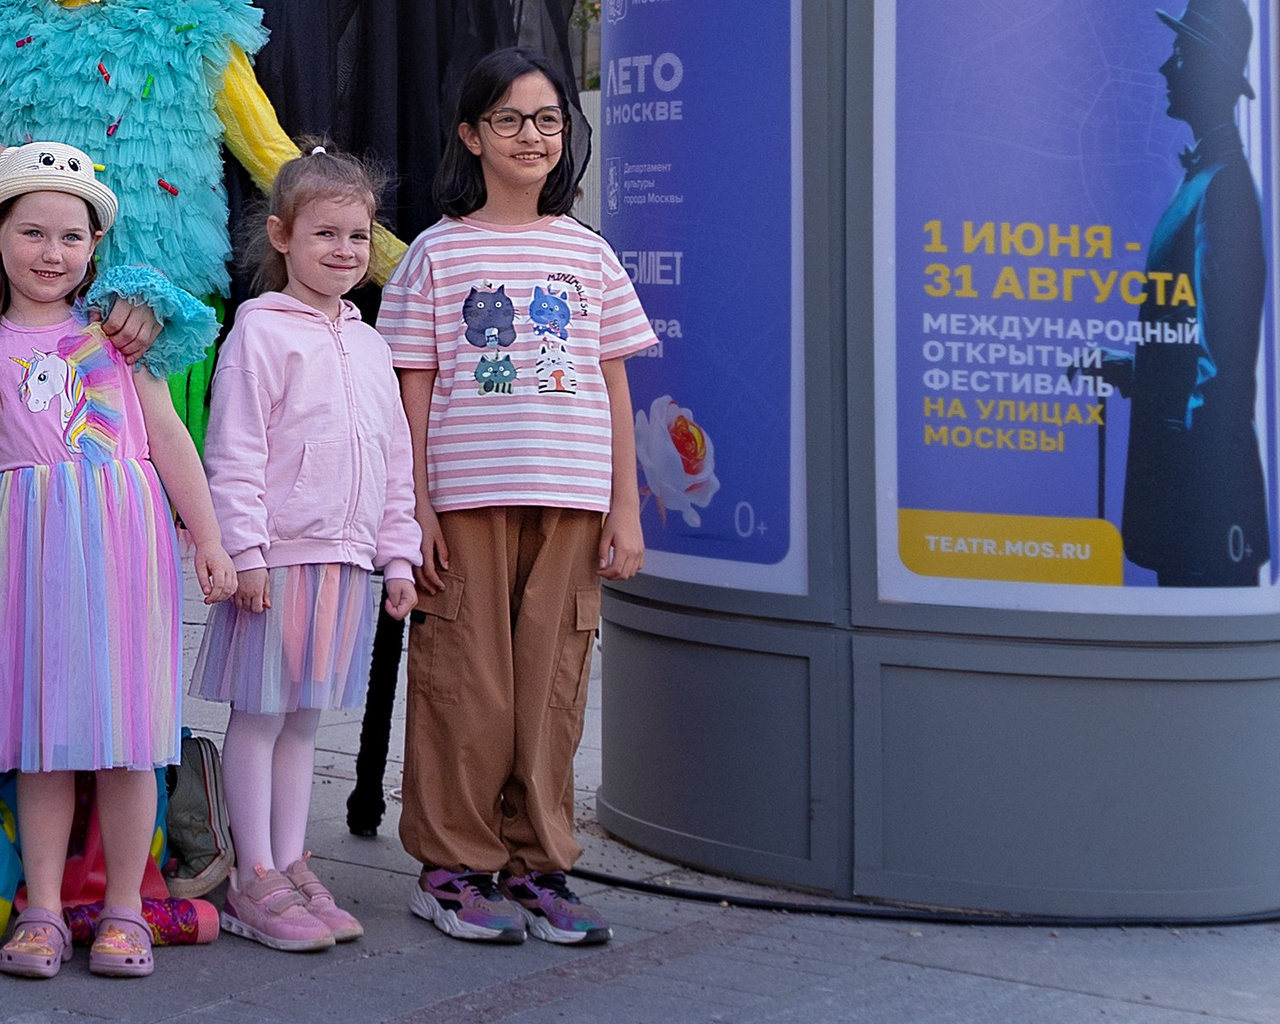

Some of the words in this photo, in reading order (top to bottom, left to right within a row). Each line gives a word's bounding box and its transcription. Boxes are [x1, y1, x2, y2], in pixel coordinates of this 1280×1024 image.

[606, 52, 684, 97] ЛЕТО
[605, 105, 612, 125] В
[613, 101, 683, 124] МОСКВЕ
[647, 192, 684, 203] Москвы
[924, 220, 947, 253] 1
[963, 221, 1113, 258] ИЮНЯ
[615, 251, 683, 285] БИЛЕТ
[923, 263, 978, 298] 31
[992, 266, 1197, 307] АВГУСТА
[922, 312, 1200, 346] МЕЖДУНАРОДНЫЙ
[922, 340, 1103, 369] ОТКРЫТЫЙ
[922, 368, 1114, 398] ФЕСТИВАЛЬ
[923, 397, 967, 420] НА
[976, 399, 1105, 426] УЛИЦАХ
[923, 425, 1065, 452] МОСКВЫ
[734, 501, 768, 538] 0+
[925, 534, 1091, 560] TEATR.MOS.RU
